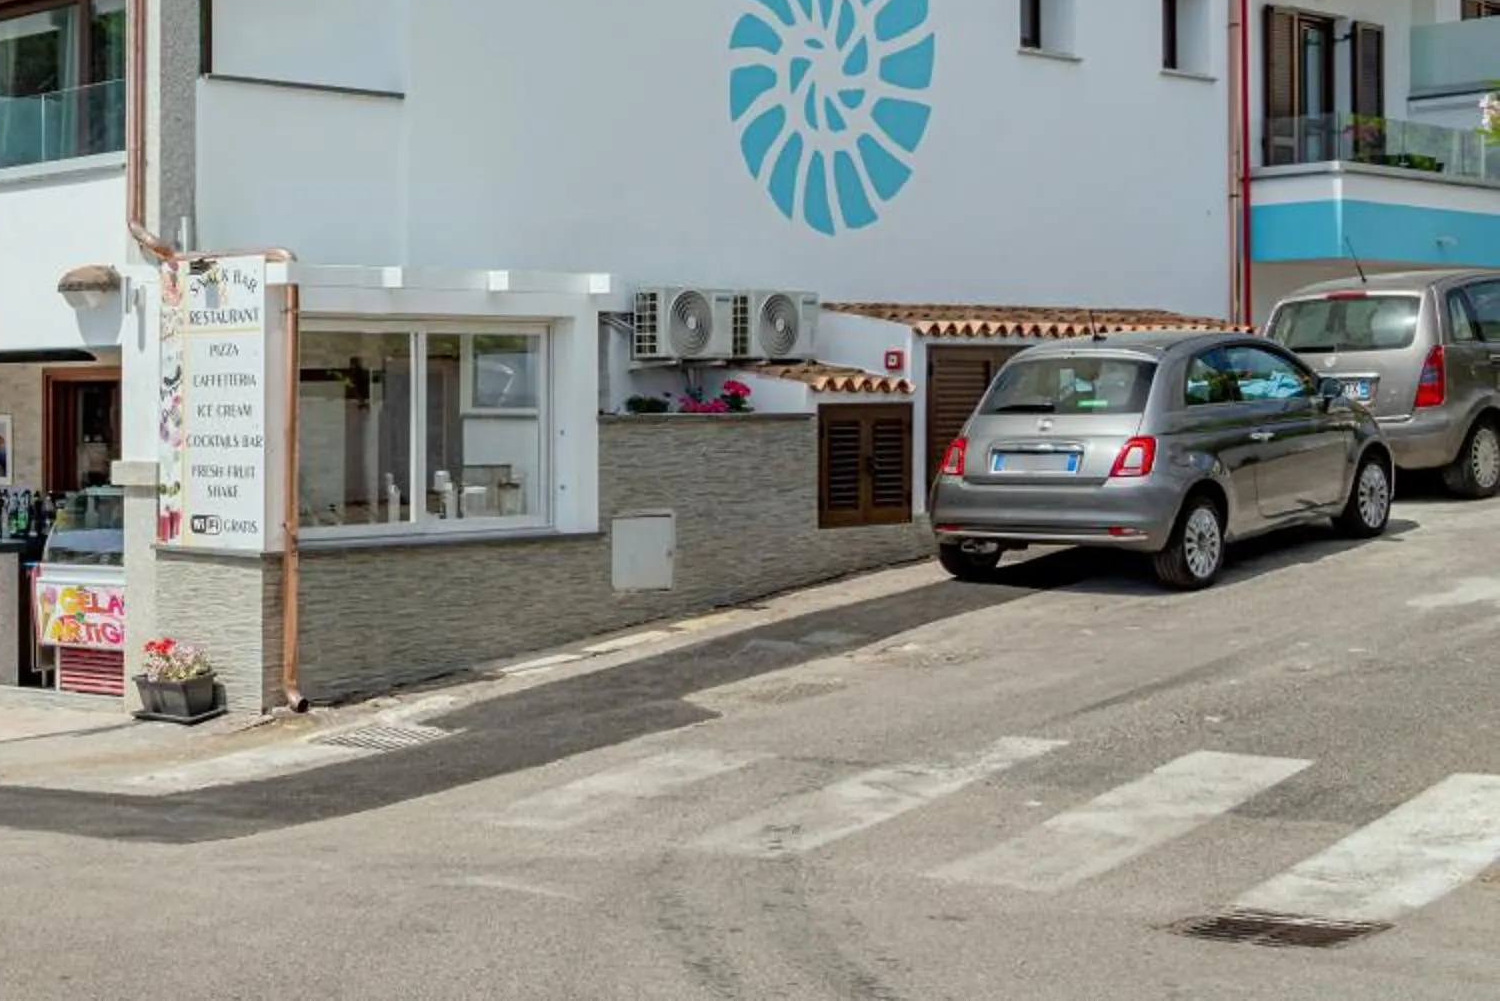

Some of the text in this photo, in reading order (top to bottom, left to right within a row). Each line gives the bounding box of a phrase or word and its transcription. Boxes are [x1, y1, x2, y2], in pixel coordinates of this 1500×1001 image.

[233, 269, 258, 294] BAR
[189, 307, 260, 326] RESTAURANT
[209, 342, 240, 357] PIZZA
[197, 404, 252, 417] ICE CREAM
[186, 435, 263, 448] COCKTAILS BAR
[192, 465, 256, 479] FRESH FRUIT
[207, 484, 239, 498] SHAKE
[223, 518, 258, 533] GRATIS
[59, 586, 125, 617] GELA
[51, 615, 125, 644] ARTIG
